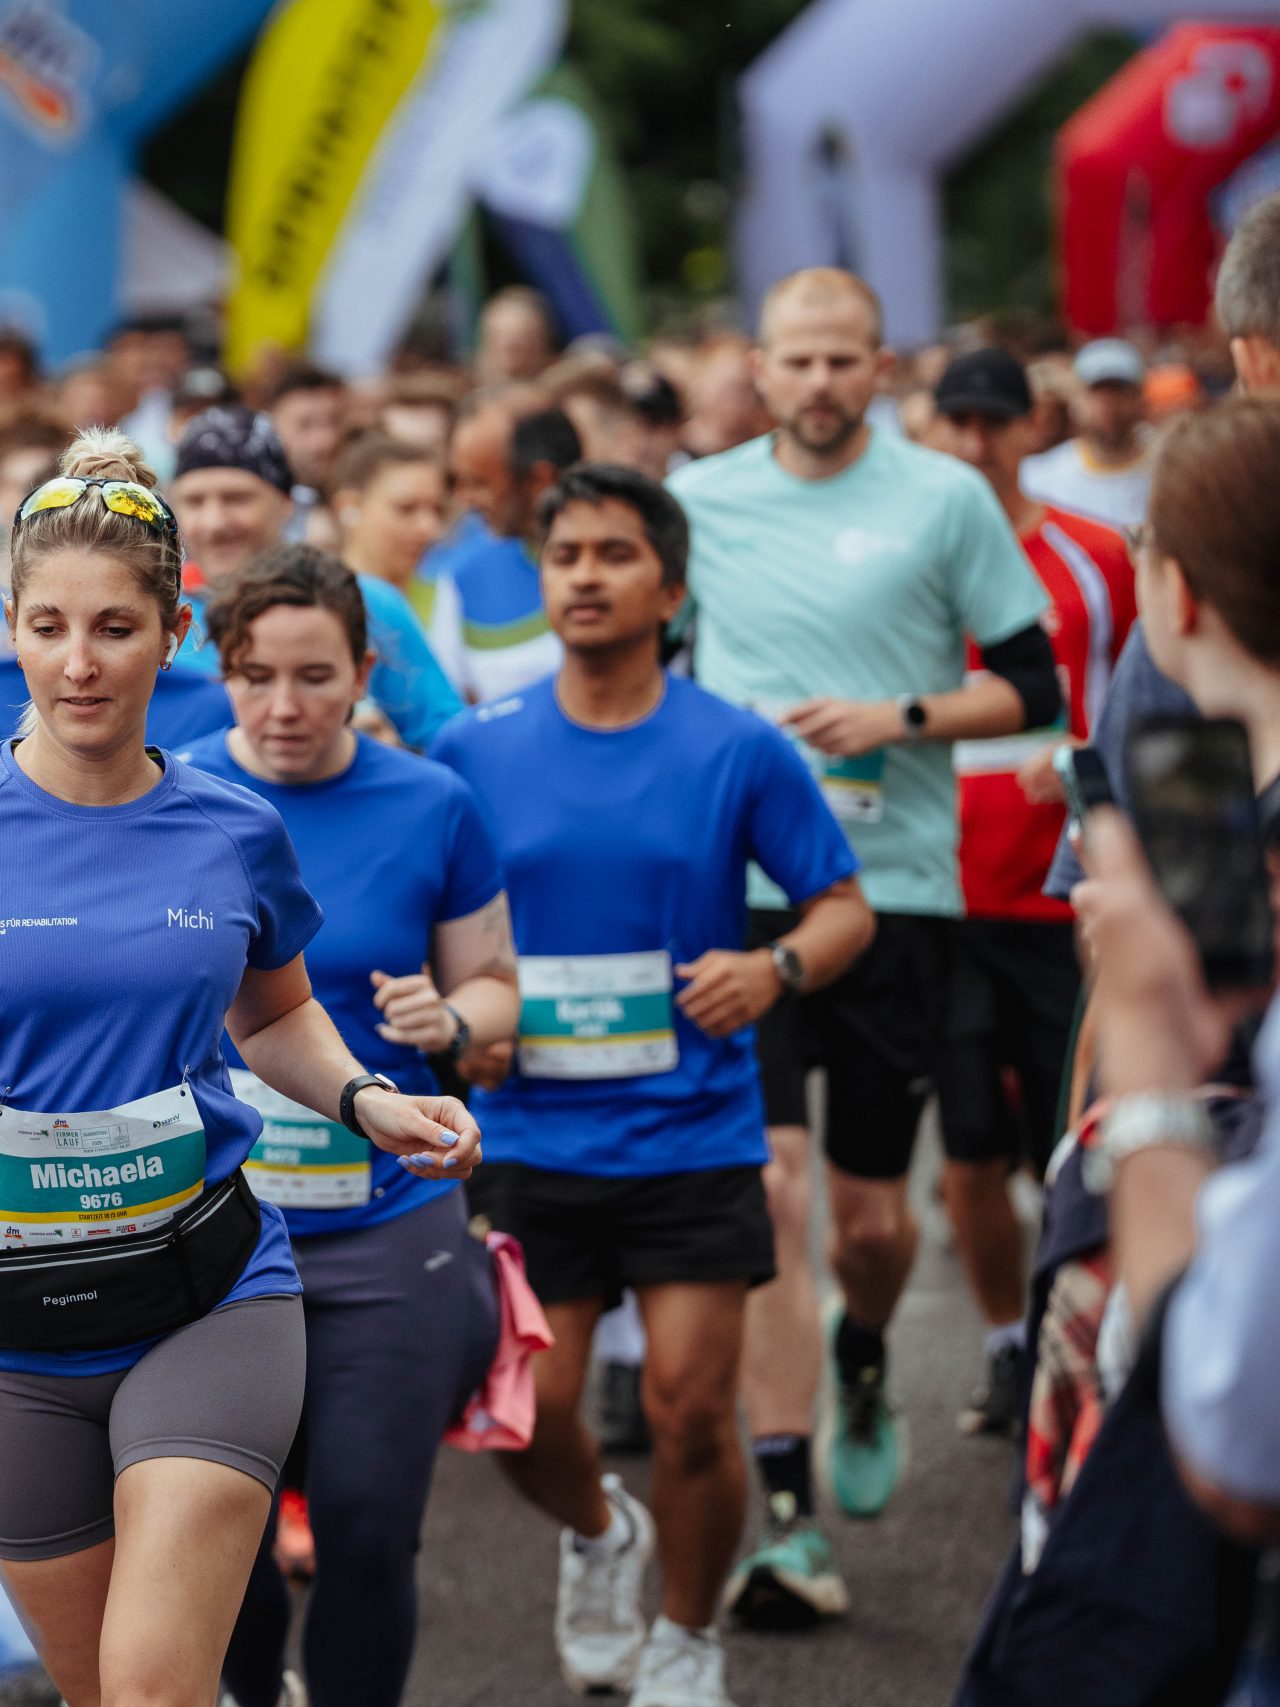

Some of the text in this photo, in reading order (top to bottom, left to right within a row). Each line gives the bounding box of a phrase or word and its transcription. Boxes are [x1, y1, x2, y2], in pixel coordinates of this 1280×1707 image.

[6, 918, 21, 927] FÜR
[22, 917, 78, 927] REHABILITATION
[167, 908, 214, 930] Michi
[57, 1138, 80, 1147] LAUF
[30, 1154, 165, 1189] Michaela
[80, 1191, 123, 1209] 9676
[6, 1226, 20, 1235] dm
[42, 1289, 98, 1306] Peginmol
